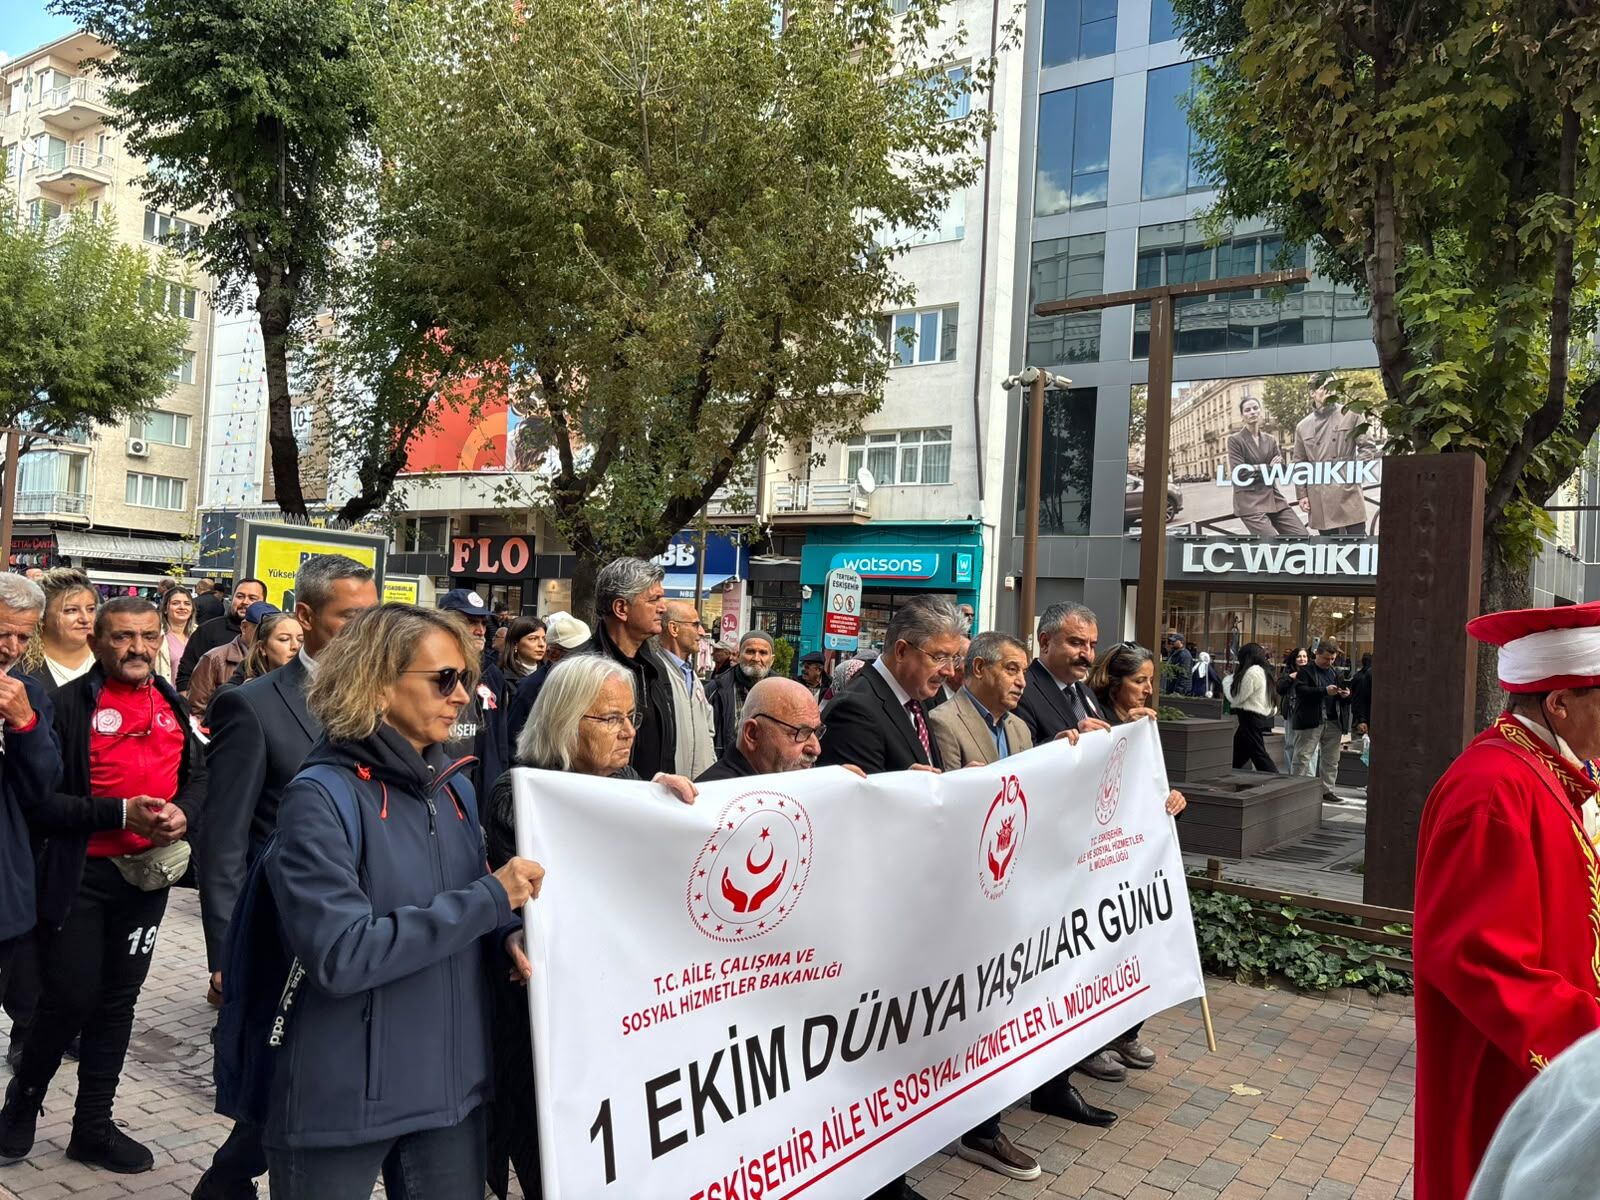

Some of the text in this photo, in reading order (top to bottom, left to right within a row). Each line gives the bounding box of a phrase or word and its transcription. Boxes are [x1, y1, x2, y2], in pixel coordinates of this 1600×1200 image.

[1216, 464, 1255, 487] LC
[450, 537, 529, 574] FLO
[650, 543, 695, 566] BB
[843, 557, 922, 571] watsons
[1182, 543, 1234, 573] LC
[1001, 775, 1019, 806] 10
[128, 926, 157, 955] 19
[654, 948, 815, 995] T.C. AİLE, ÇALIŞMA VE
[622, 961, 842, 1035] SOSYAL HİZMETLER BAKANLIĞI
[590, 869, 1173, 1185] 1 EKİM DÜNYA YAŞLILAR GÜNÜ
[689, 956, 1141, 1200] KİŞEHİR AİLE VE SOSYAL HİZMETLER İL MÜDÜRLÜĞÜ
